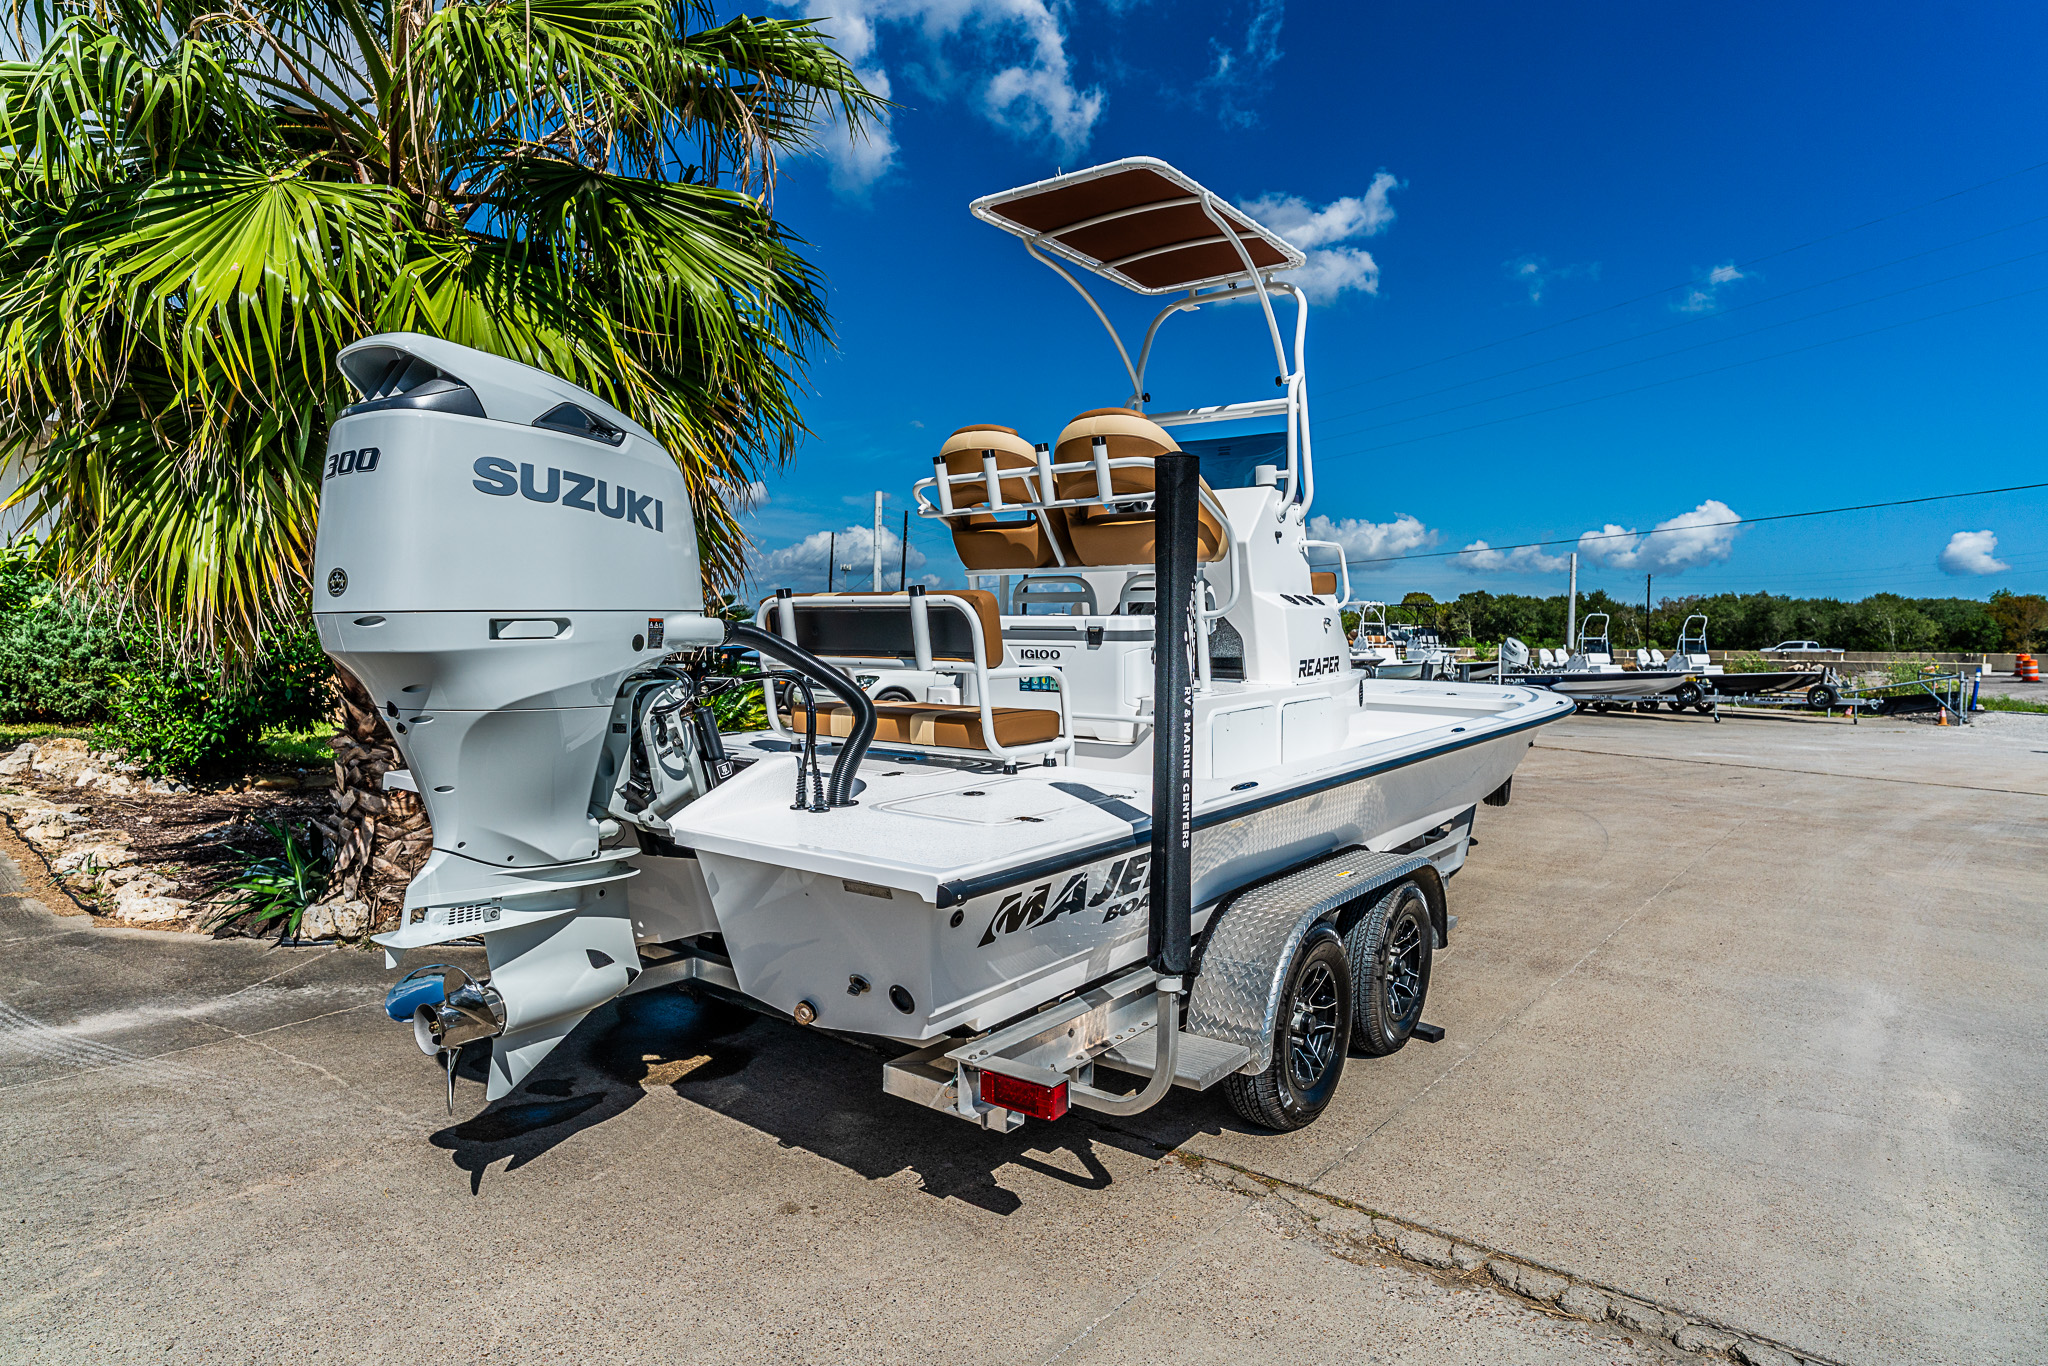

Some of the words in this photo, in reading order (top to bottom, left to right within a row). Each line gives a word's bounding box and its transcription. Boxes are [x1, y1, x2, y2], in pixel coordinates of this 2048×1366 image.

[325, 447, 381, 480] 300
[473, 456, 664, 533] SUZUKI
[1020, 649, 1061, 660] IGLOO
[1298, 655, 1340, 678] REAPER
[1184, 686, 1192, 706] RV
[1184, 709, 1191, 717] &
[1183, 722, 1191, 778] MARINE
[1182, 783, 1190, 849] CENTERS
[977, 852, 1151, 948] MAJE
[1102, 893, 1150, 924] BOA
